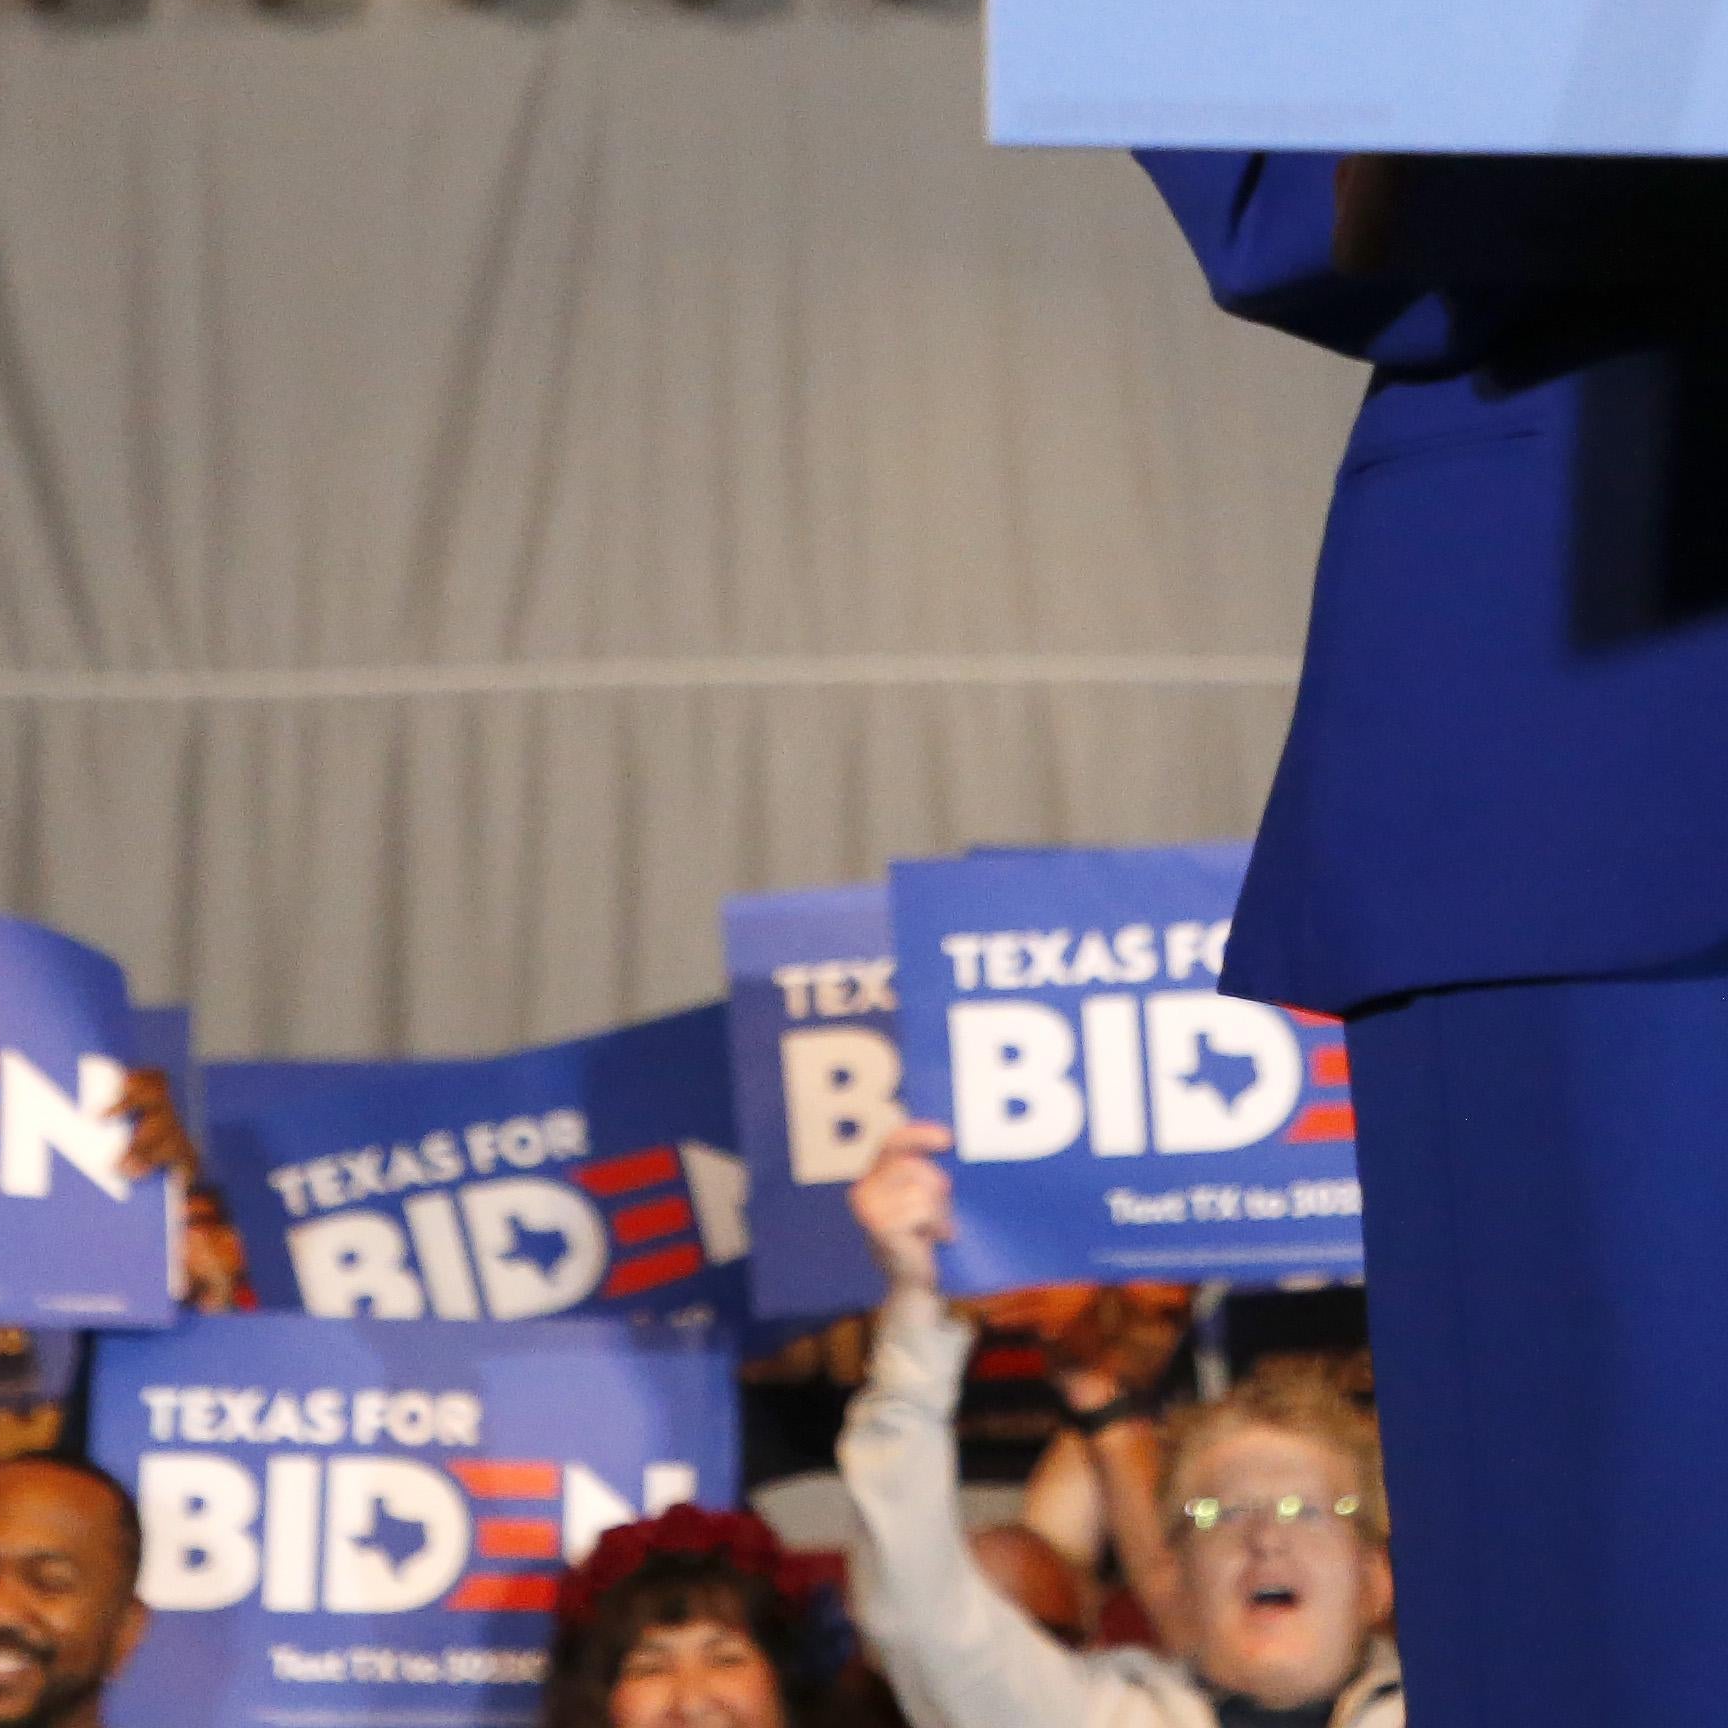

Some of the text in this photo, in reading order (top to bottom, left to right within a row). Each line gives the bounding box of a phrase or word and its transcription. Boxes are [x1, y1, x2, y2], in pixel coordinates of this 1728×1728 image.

[774, 957, 899, 1021] TEX
[942, 924, 1156, 990] TEXAS
[268, 1108, 591, 1217] TEXAS FOR
[140, 1385, 483, 1449] TEXAS FOR
